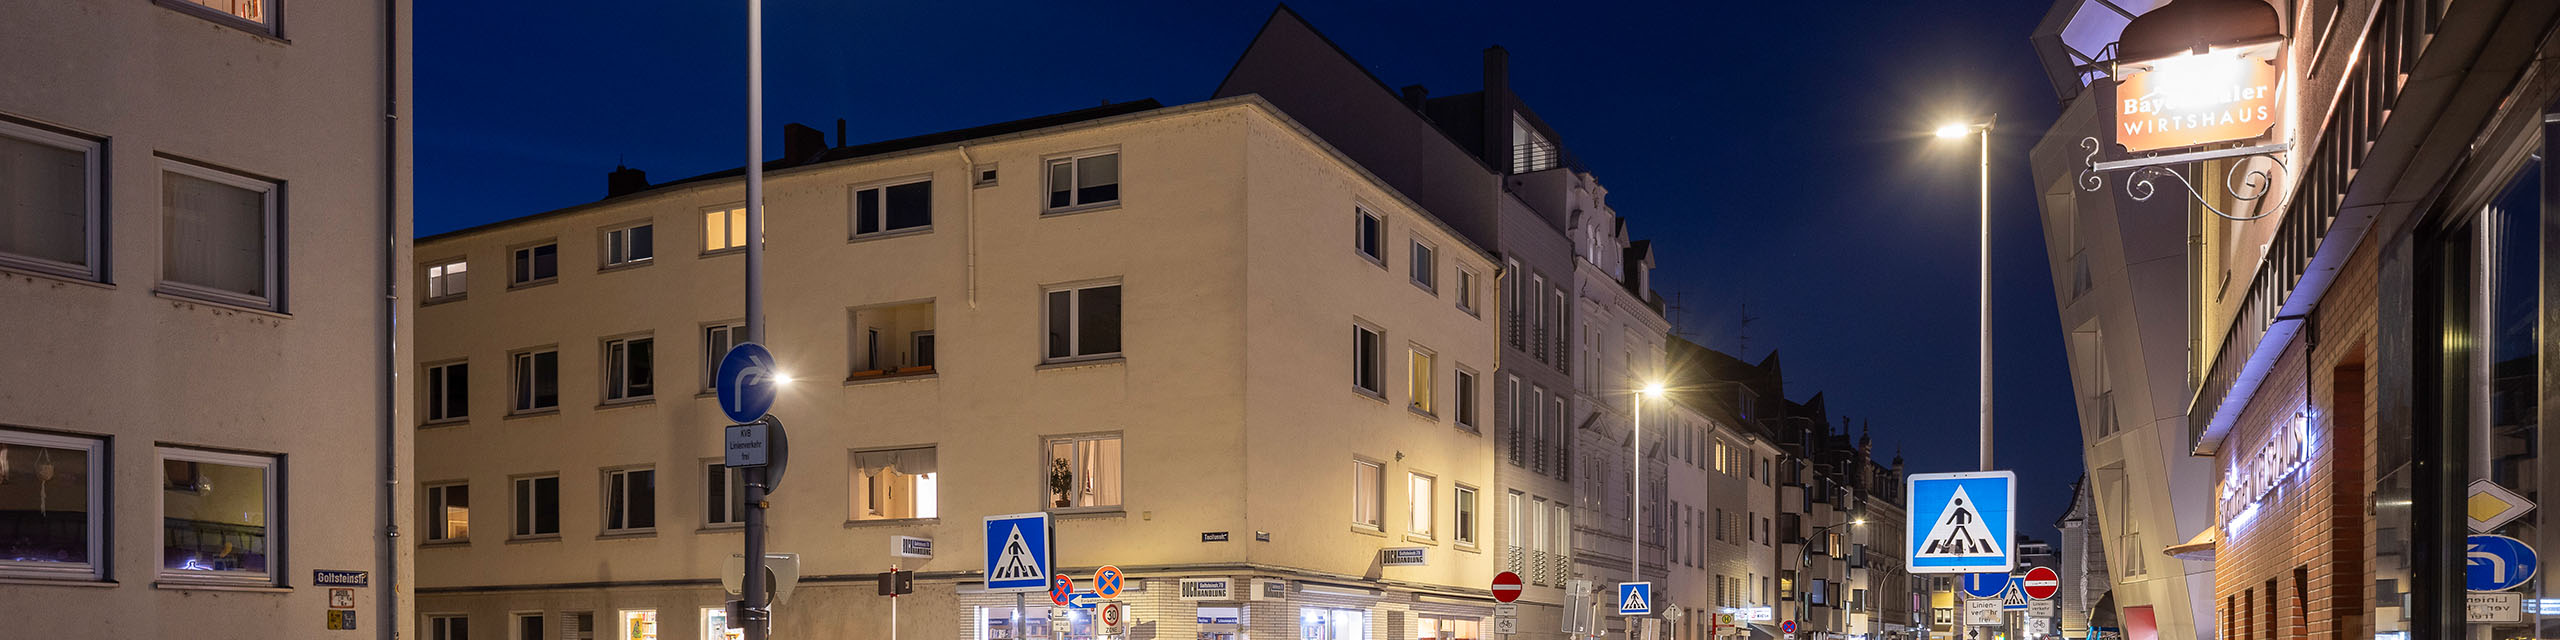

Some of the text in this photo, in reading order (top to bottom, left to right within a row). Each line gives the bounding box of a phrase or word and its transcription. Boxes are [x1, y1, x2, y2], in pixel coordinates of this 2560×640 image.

[2124, 105, 2268, 136] WIRTSHAUS
[1182, 581, 1197, 597] BUCH
[1197, 589, 1226, 597] HANDLUNG
[1106, 609, 1117, 621] 30
